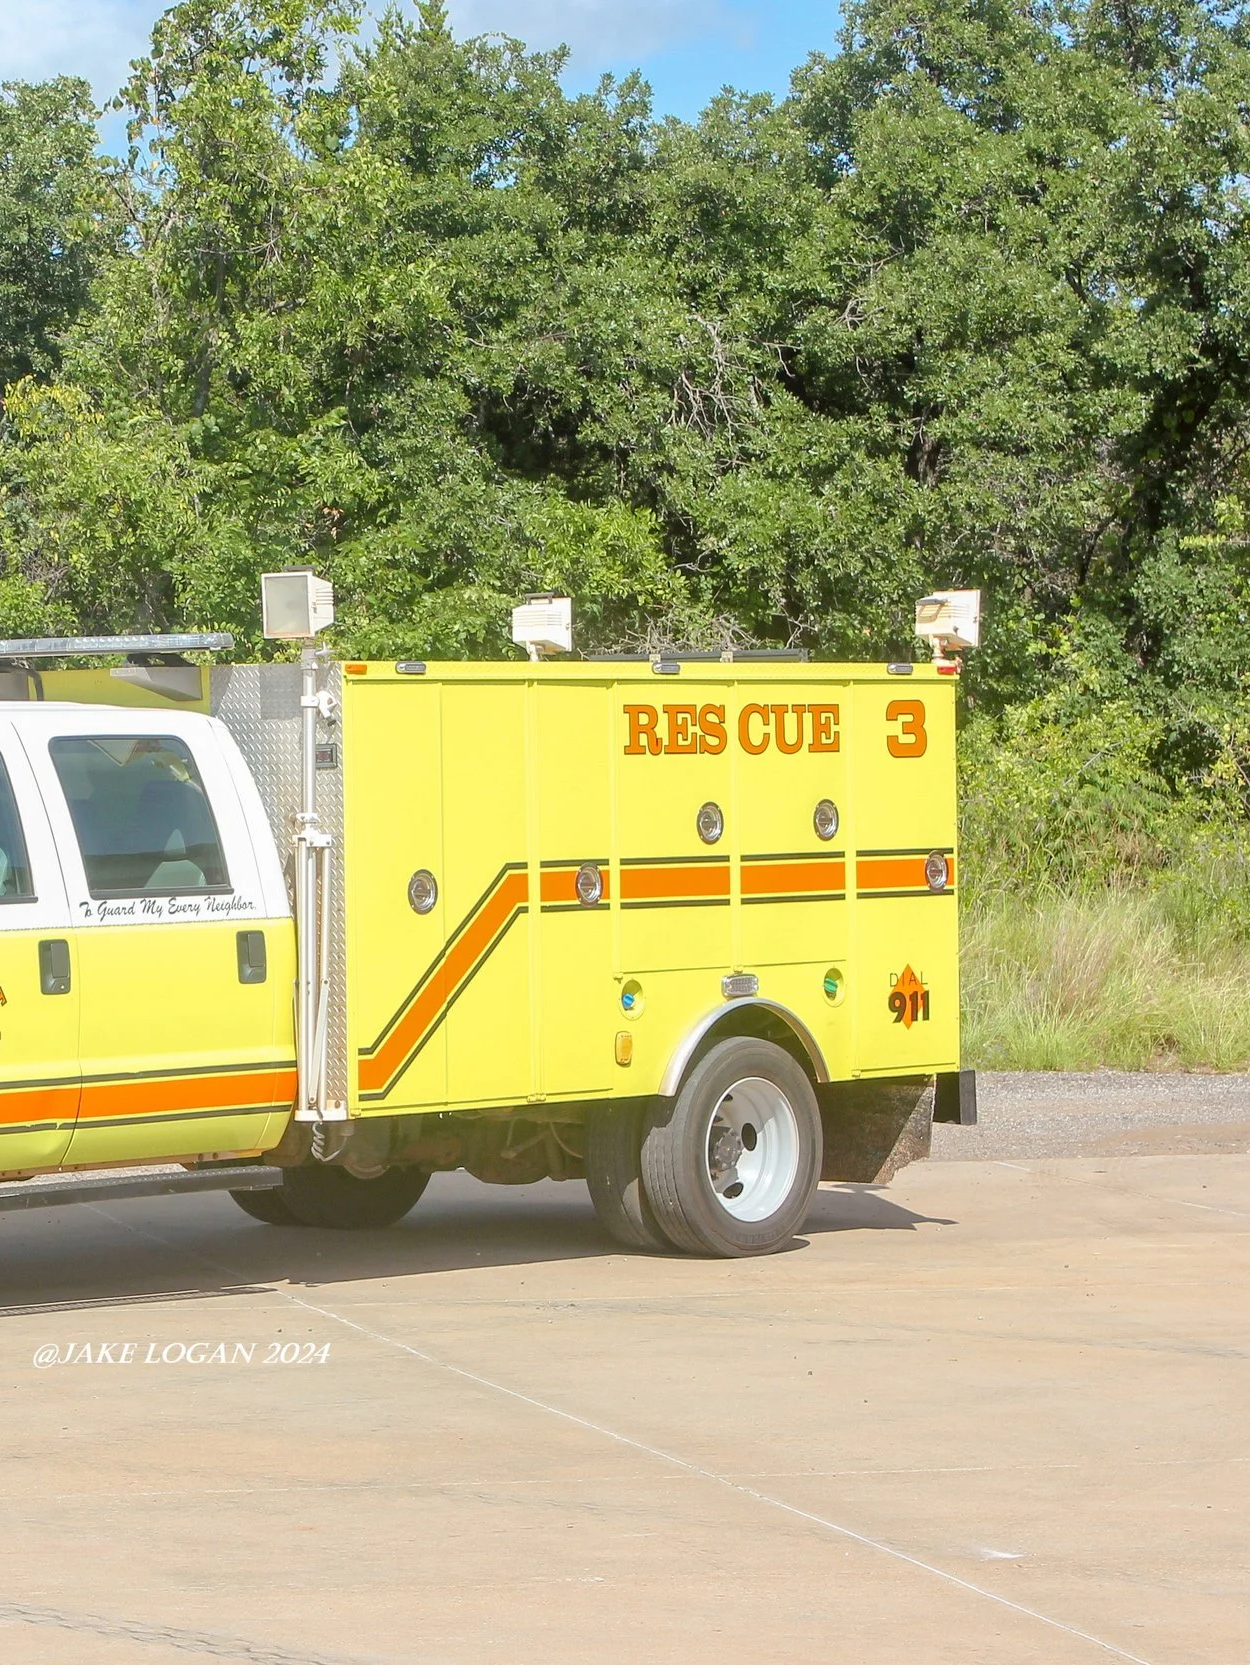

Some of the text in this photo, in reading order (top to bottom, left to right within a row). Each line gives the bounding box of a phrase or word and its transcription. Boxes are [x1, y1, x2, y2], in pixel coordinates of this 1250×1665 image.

[623, 700, 927, 758] RESCUE 3
[79, 902, 93, 918] To
[97, 901, 135, 922] Guard
[140, 898, 163, 918] My
[167, 897, 200, 916] Every
[889, 971, 929, 988] DIAL
[888, 990, 930, 1023] 911
